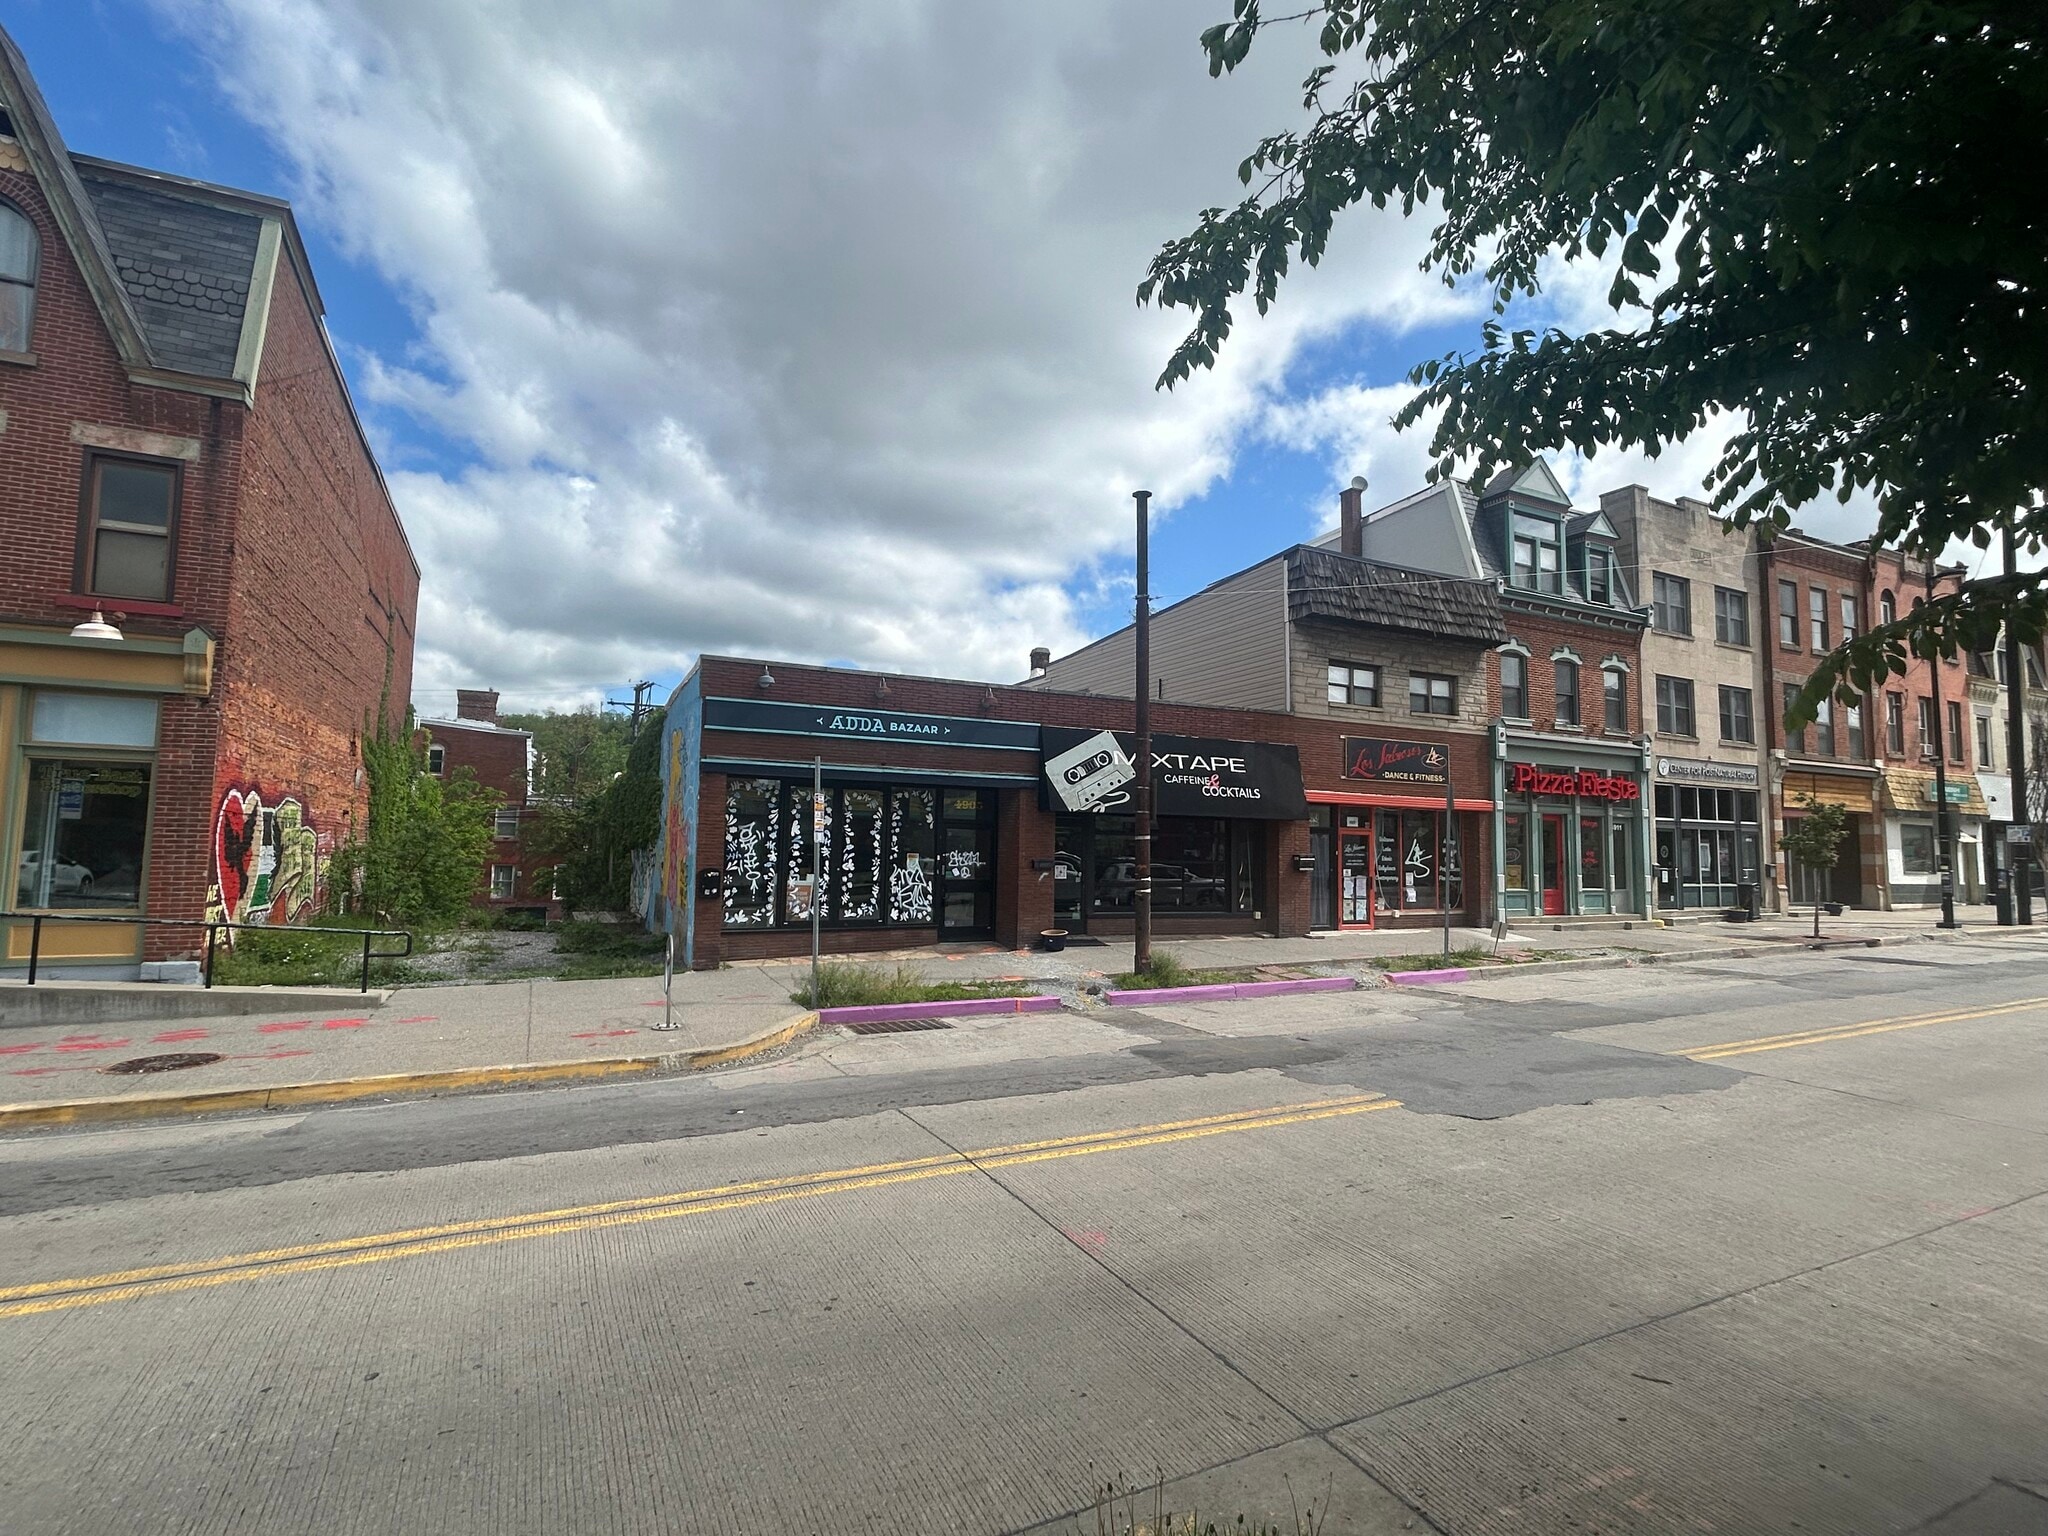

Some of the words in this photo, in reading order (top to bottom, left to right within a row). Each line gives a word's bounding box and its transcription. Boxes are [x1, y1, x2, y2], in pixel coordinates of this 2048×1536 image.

[829, 715, 886, 733] ADDA
[889, 722, 938, 735] BAZAAR
[1113, 750, 1247, 773] MXTAPE
[1164, 774, 1210, 785] CAFFEINE
[1209, 773, 1220, 787] &
[1384, 771, 1408, 780] DANCE
[1415, 774, 1443, 782] FITNESS
[1515, 764, 1576, 795] Pizza
[1579, 770, 1640, 800] Fiesta
[1202, 786, 1261, 799] COCKTAILS
